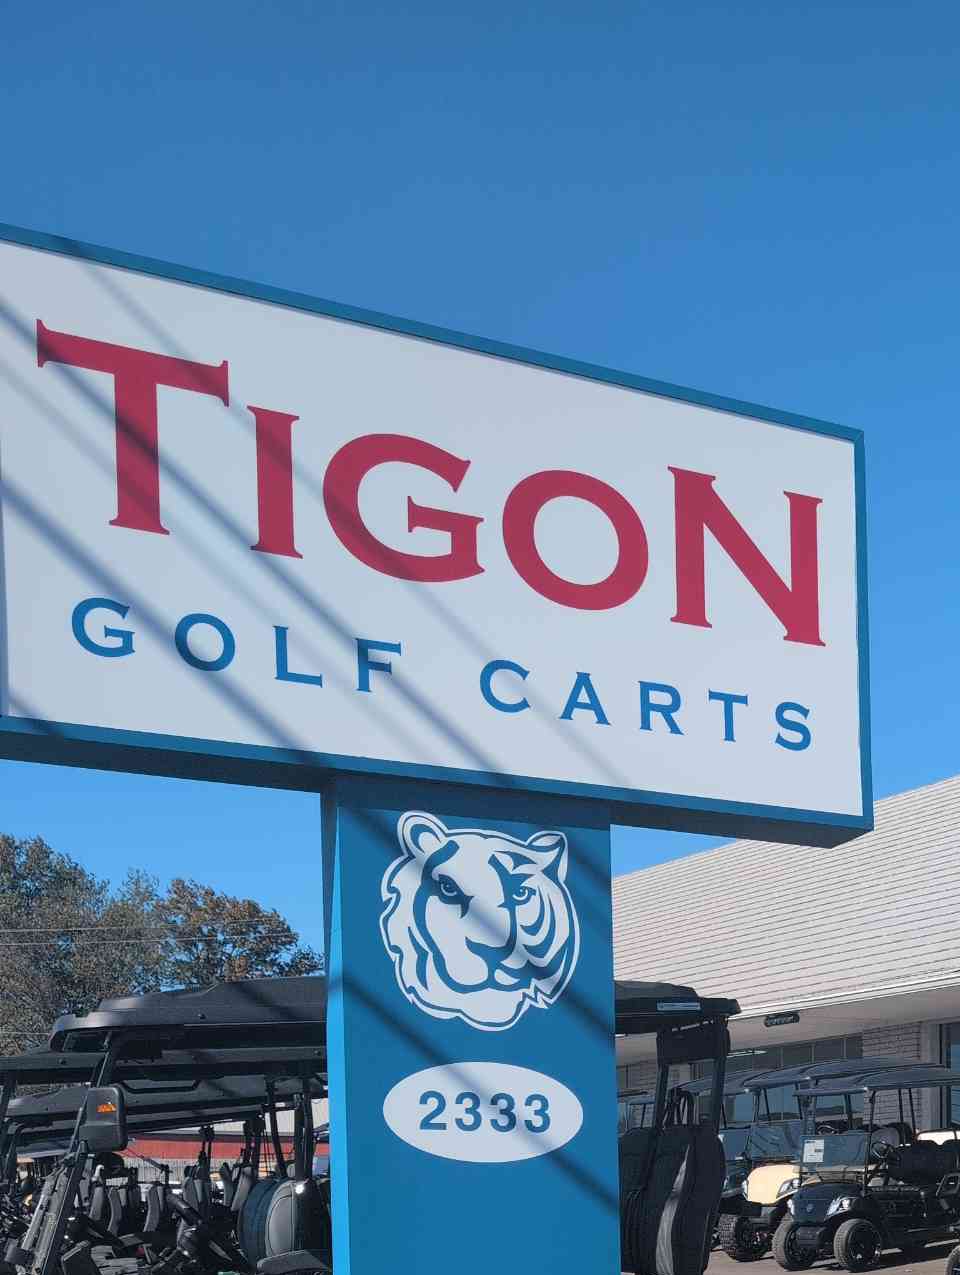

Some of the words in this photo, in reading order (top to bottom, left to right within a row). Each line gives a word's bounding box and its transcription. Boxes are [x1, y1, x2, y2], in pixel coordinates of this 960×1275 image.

[36, 319, 826, 647] TIGON
[71, 596, 402, 693] GOLF
[479, 659, 813, 752] CARTS
[419, 1090, 551, 1134] 2333
